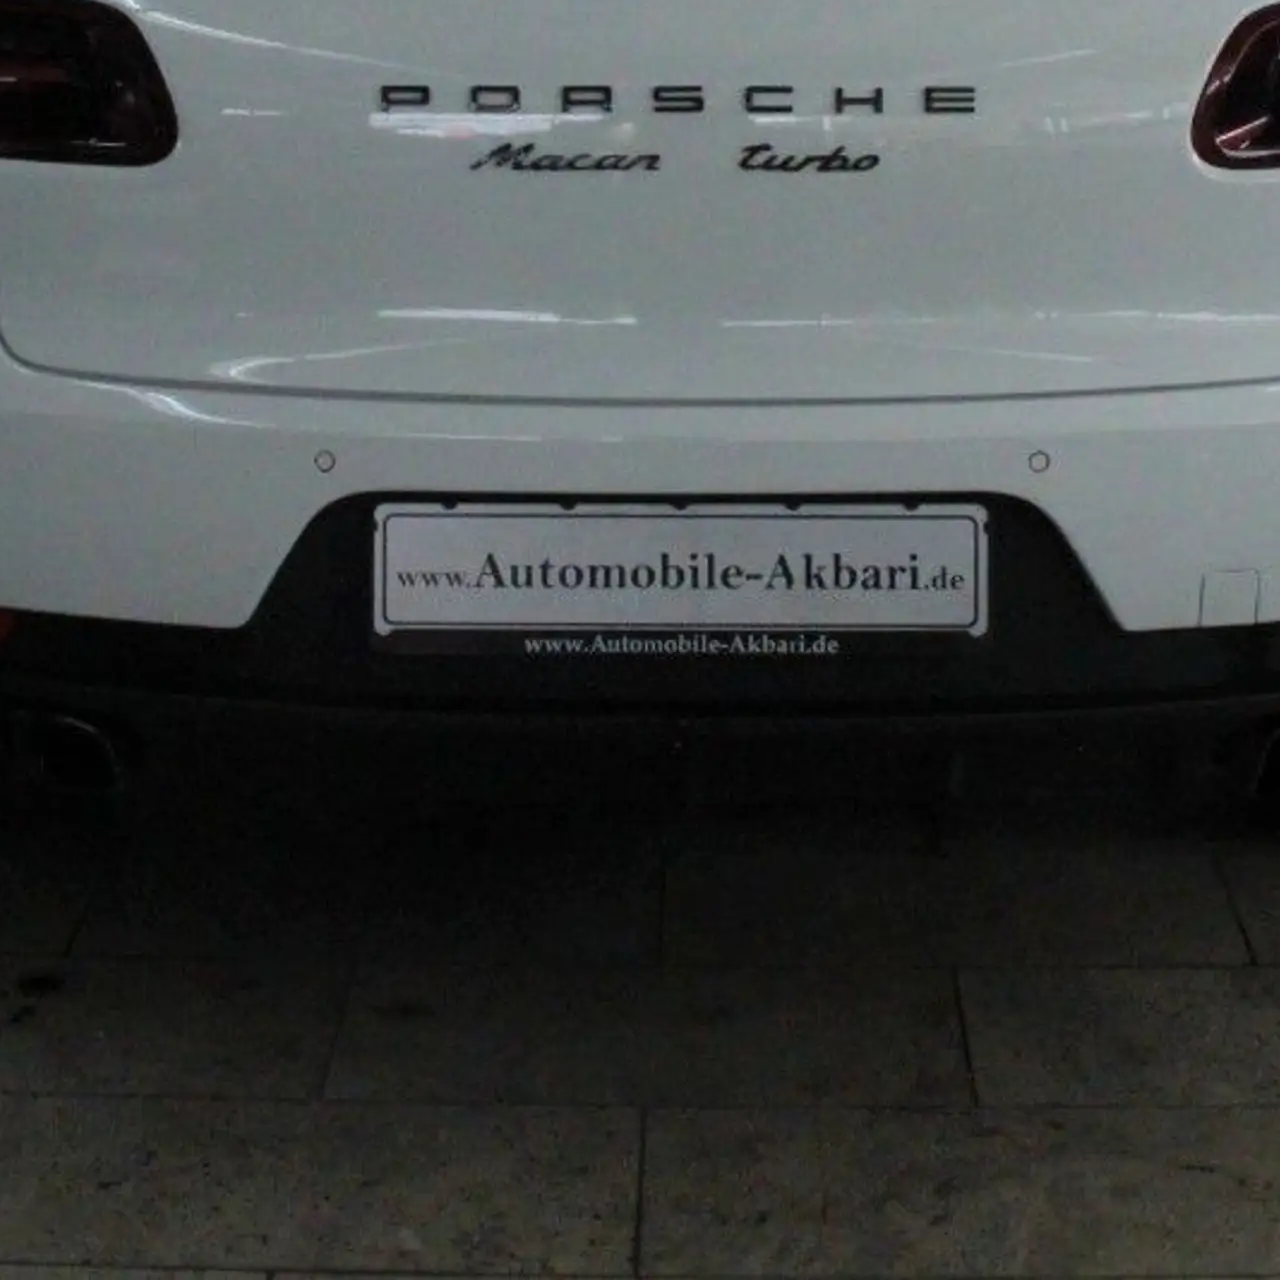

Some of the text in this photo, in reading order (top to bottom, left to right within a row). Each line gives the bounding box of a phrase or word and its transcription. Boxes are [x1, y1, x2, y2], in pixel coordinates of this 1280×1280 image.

[380, 84, 975, 114] PORSCHE
[470, 143, 881, 173] Macan turbo
[397, 551, 965, 593] www.Automobile-Akbari.de
[525, 633, 840, 655] www.Automobile-Akbari.de
